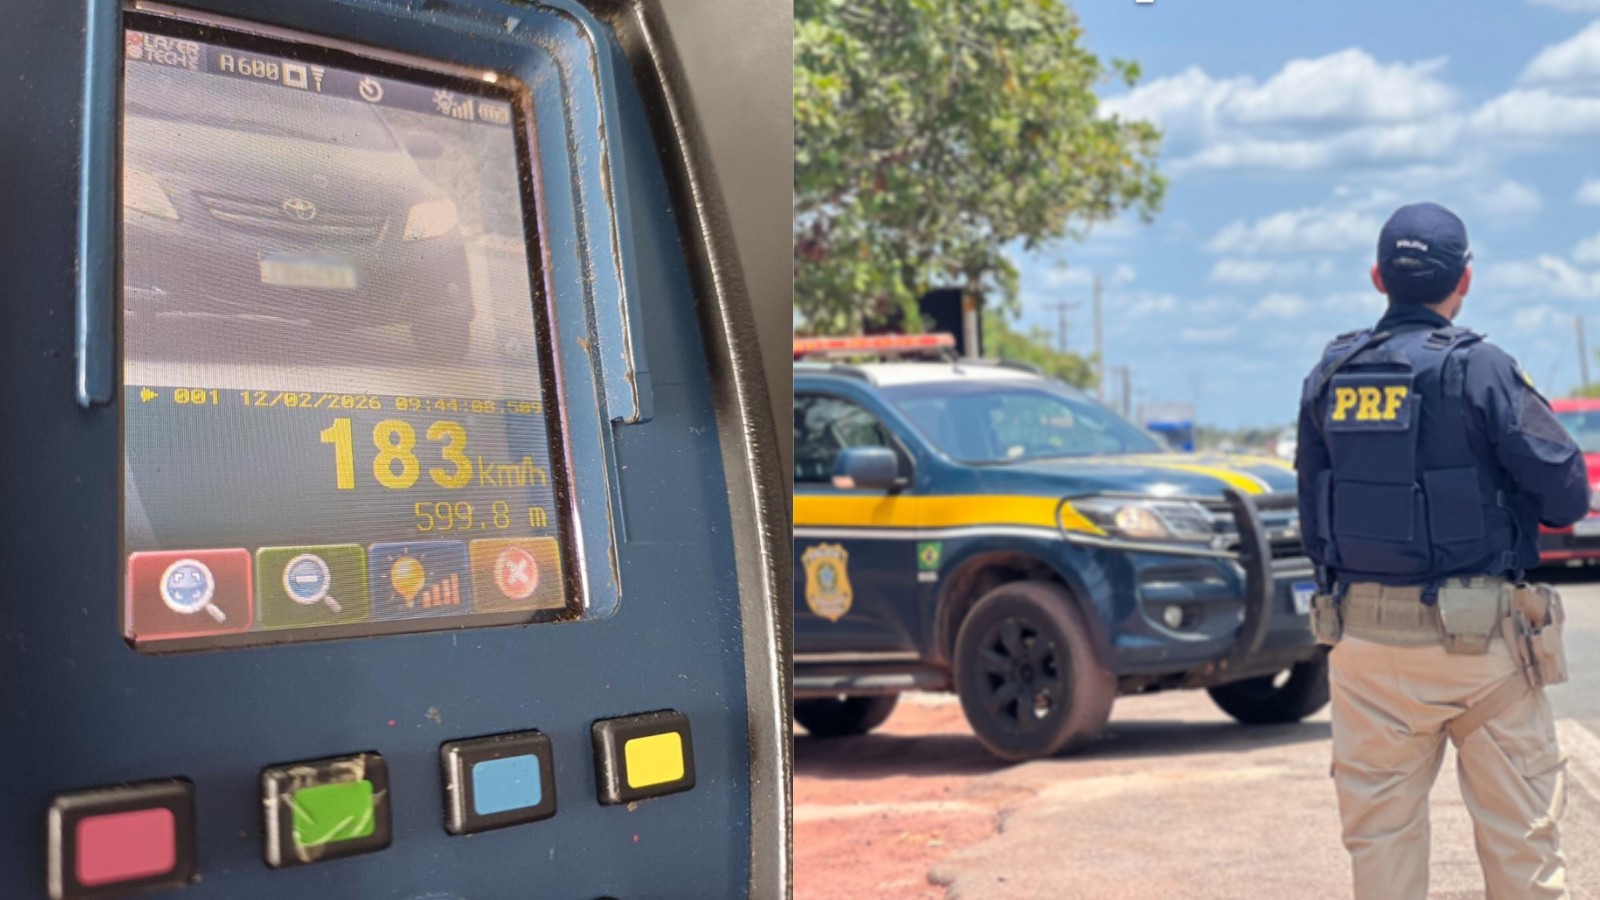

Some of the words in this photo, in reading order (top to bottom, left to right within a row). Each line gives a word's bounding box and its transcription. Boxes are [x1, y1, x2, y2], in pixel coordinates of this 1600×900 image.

[174, 387, 220, 405] 001
[240, 390, 383, 410] 12/02/2026
[1331, 386, 1409, 422] PRF
[320, 418, 474, 490] 183
[478, 455, 548, 488] km/h
[414, 501, 511, 532] 599.8
[529, 506, 547, 528] m
